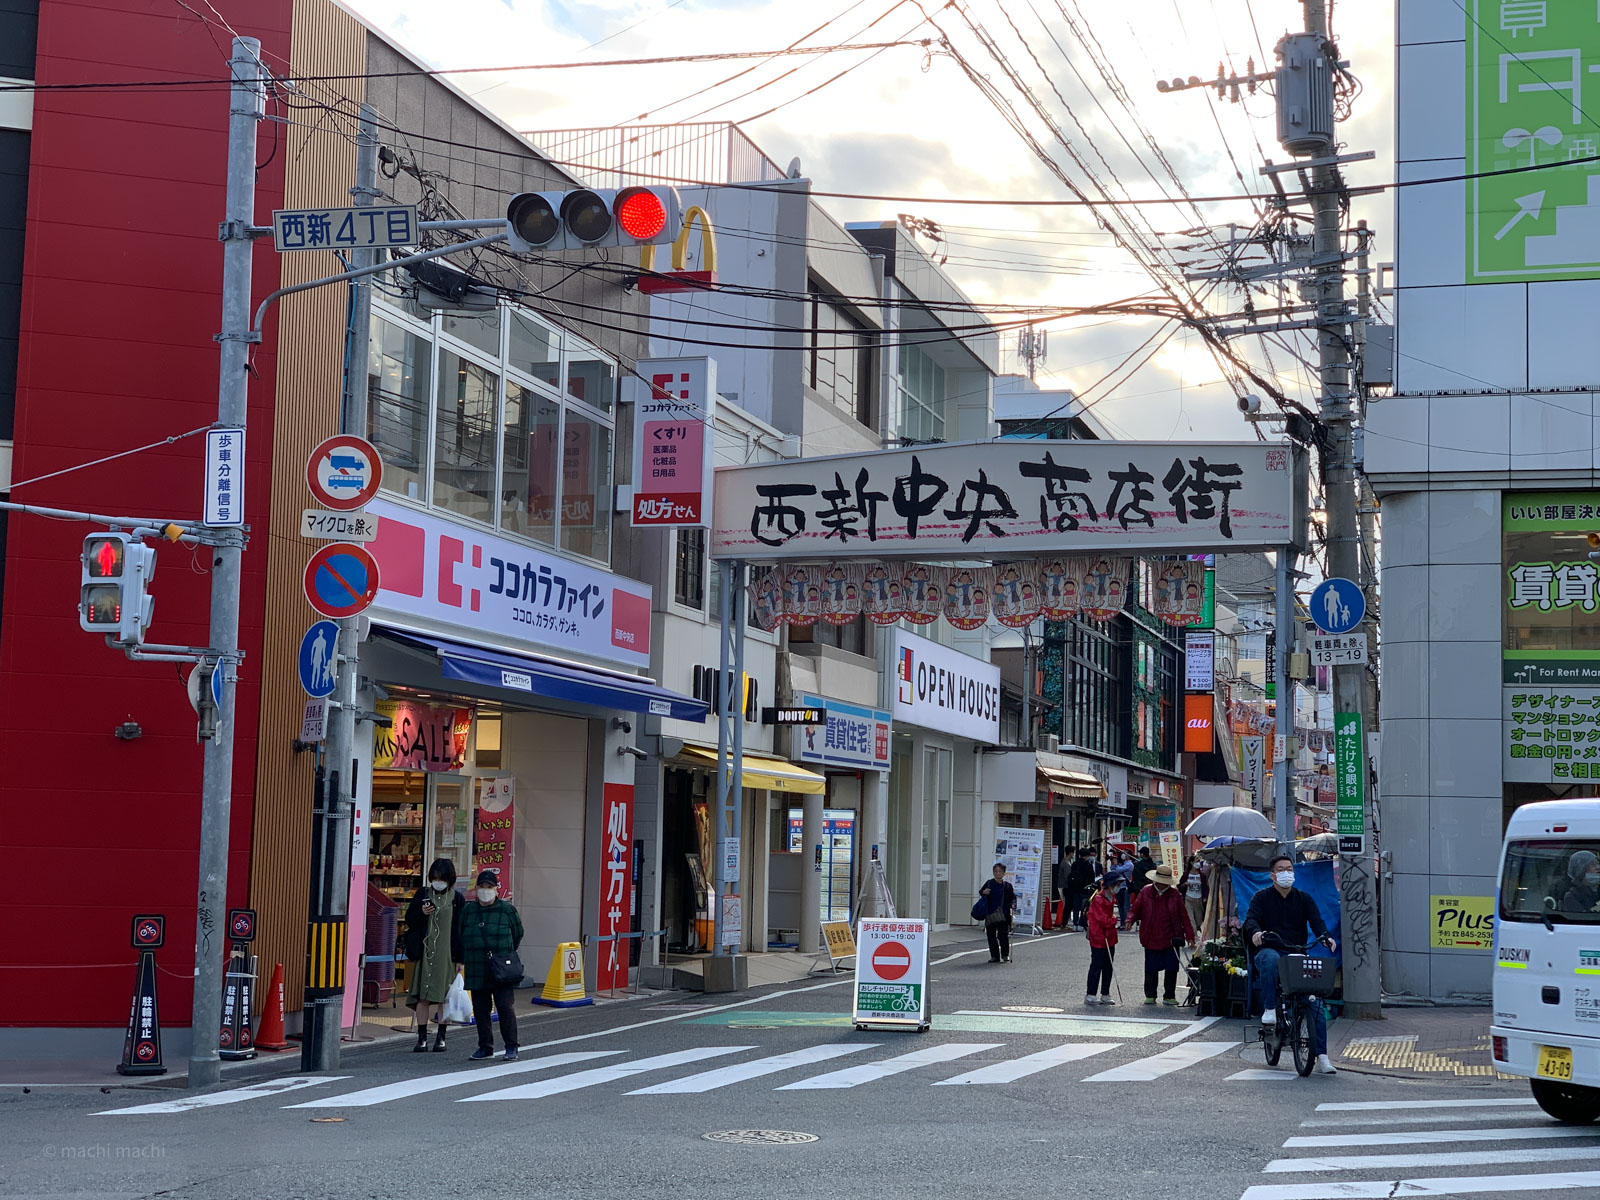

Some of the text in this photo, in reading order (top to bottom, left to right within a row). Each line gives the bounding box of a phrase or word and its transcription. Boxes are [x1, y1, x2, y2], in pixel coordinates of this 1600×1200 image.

[280, 210, 411, 248] 西新4丁目
[642, 403, 699, 413] ココカラファイン
[653, 427, 687, 440] くすり
[653, 445, 677, 454] 医薬品
[653, 457, 677, 466] 化粧品
[216, 434, 233, 522] 歩車分離信号
[653, 469, 676, 478] 日用品
[751, 451, 1242, 546] 西新中央商店街
[638, 498, 697, 521] 処方せん
[306, 515, 373, 538] マイクロを除く
[489, 557, 605, 620] ココカラファイン
[1509, 563, 1600, 612] 賃貸
[512, 607, 580, 637] ココロ、カラダ、ゲンキ。
[1315, 638, 1363, 650] 軽車両を除く
[1540, 668, 1555, 677] For
[1557, 668, 1580, 677] Rent
[918, 661, 997, 722] OPEN HOUSE
[777, 710, 819, 722] DOUTOR
[1187, 718, 1210, 729] au
[1512, 712, 1600, 726] マンション・
[400, 717, 452, 763] SALE
[825, 716, 868, 754] 賃貸住宅
[1510, 744, 1600, 759] 敷金0円・メ
[1345, 738, 1358, 798] たける眼科
[606, 801, 628, 972] 処方せん
[1439, 899, 1459, 907] 美容室
[1437, 909, 1495, 930] Plus
[863, 924, 923, 933] 歩行者優先道路
[1438, 938, 1453, 946] 入口
[1499, 947, 1531, 962] DUSKIN
[861, 985, 905, 993] おしチャリロード
[223, 985, 236, 1026] 駐輪禁止
[141, 996, 153, 1039] 駐輪禁止
[1544, 1060, 1571, 1077] 43-09
